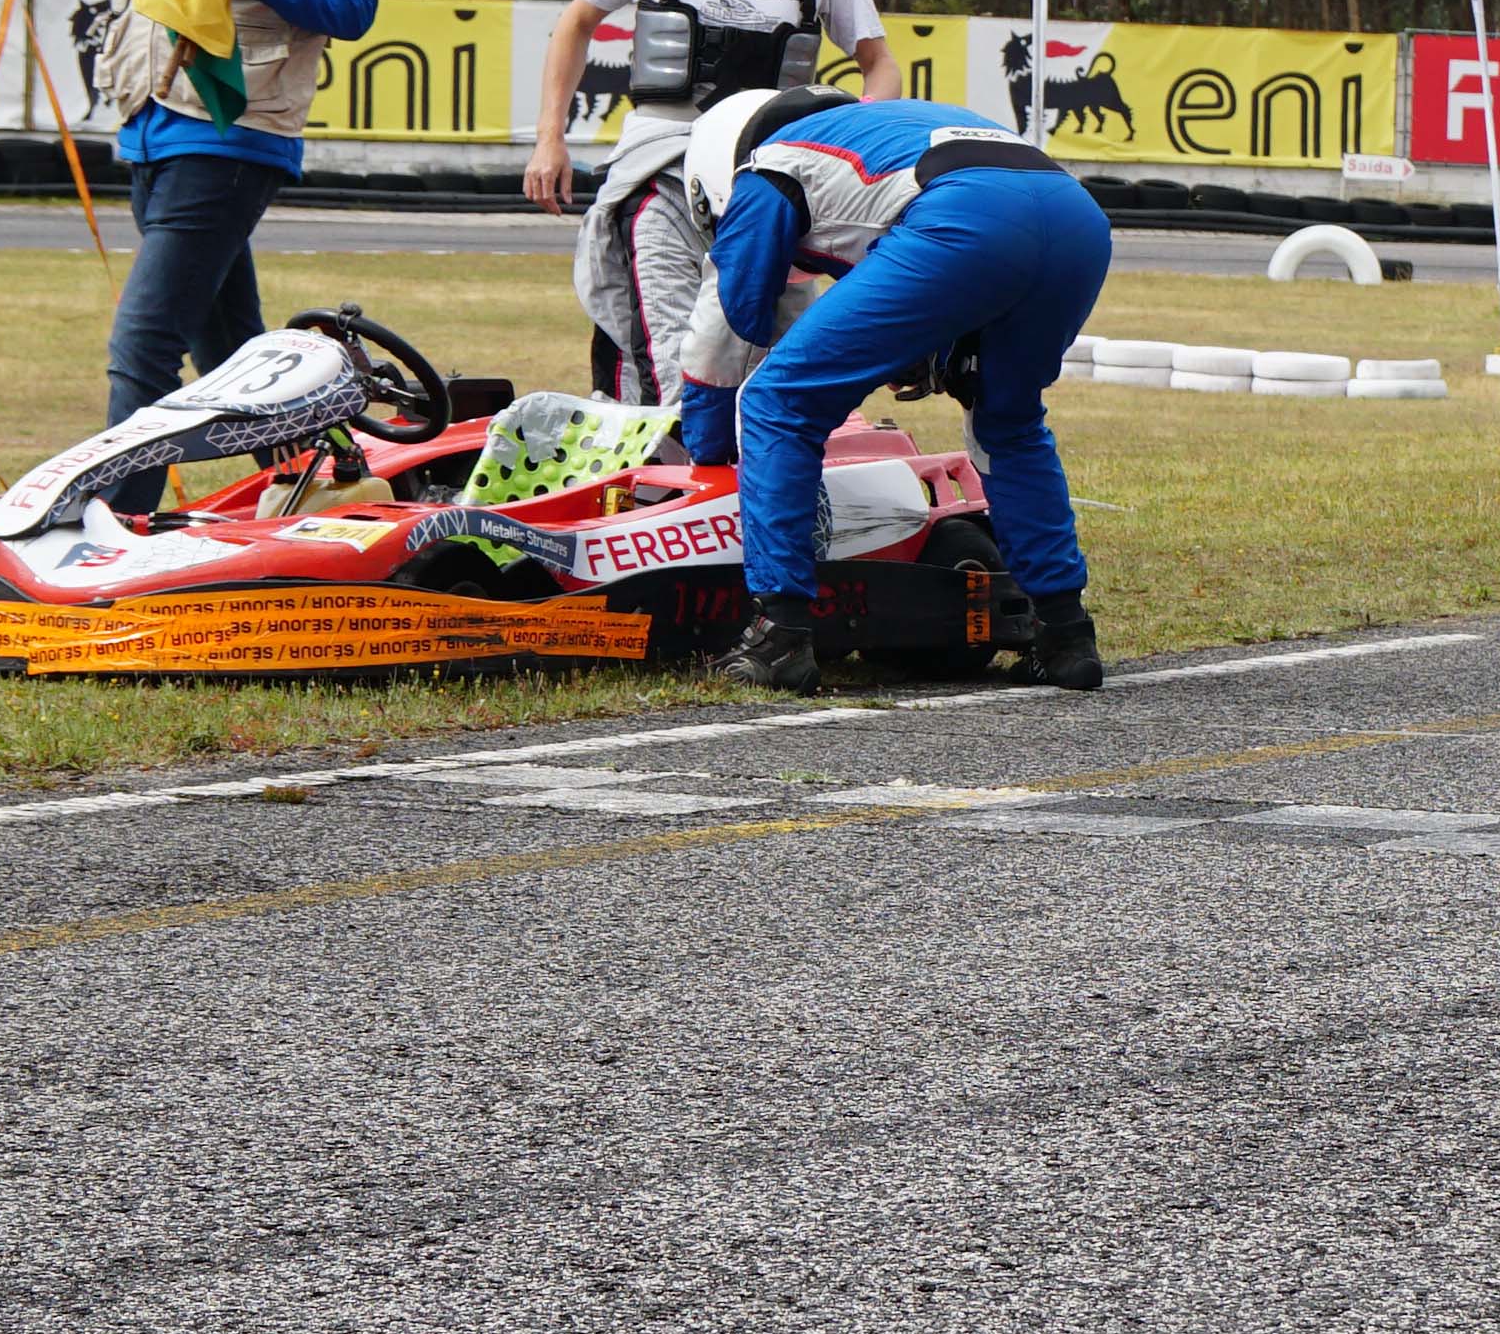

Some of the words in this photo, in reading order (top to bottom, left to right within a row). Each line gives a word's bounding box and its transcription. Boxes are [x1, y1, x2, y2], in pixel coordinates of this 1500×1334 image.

[1166, 43, 1362, 158] eni
[480, 518, 525, 543] Metallic
[527, 530, 568, 558] Structures
